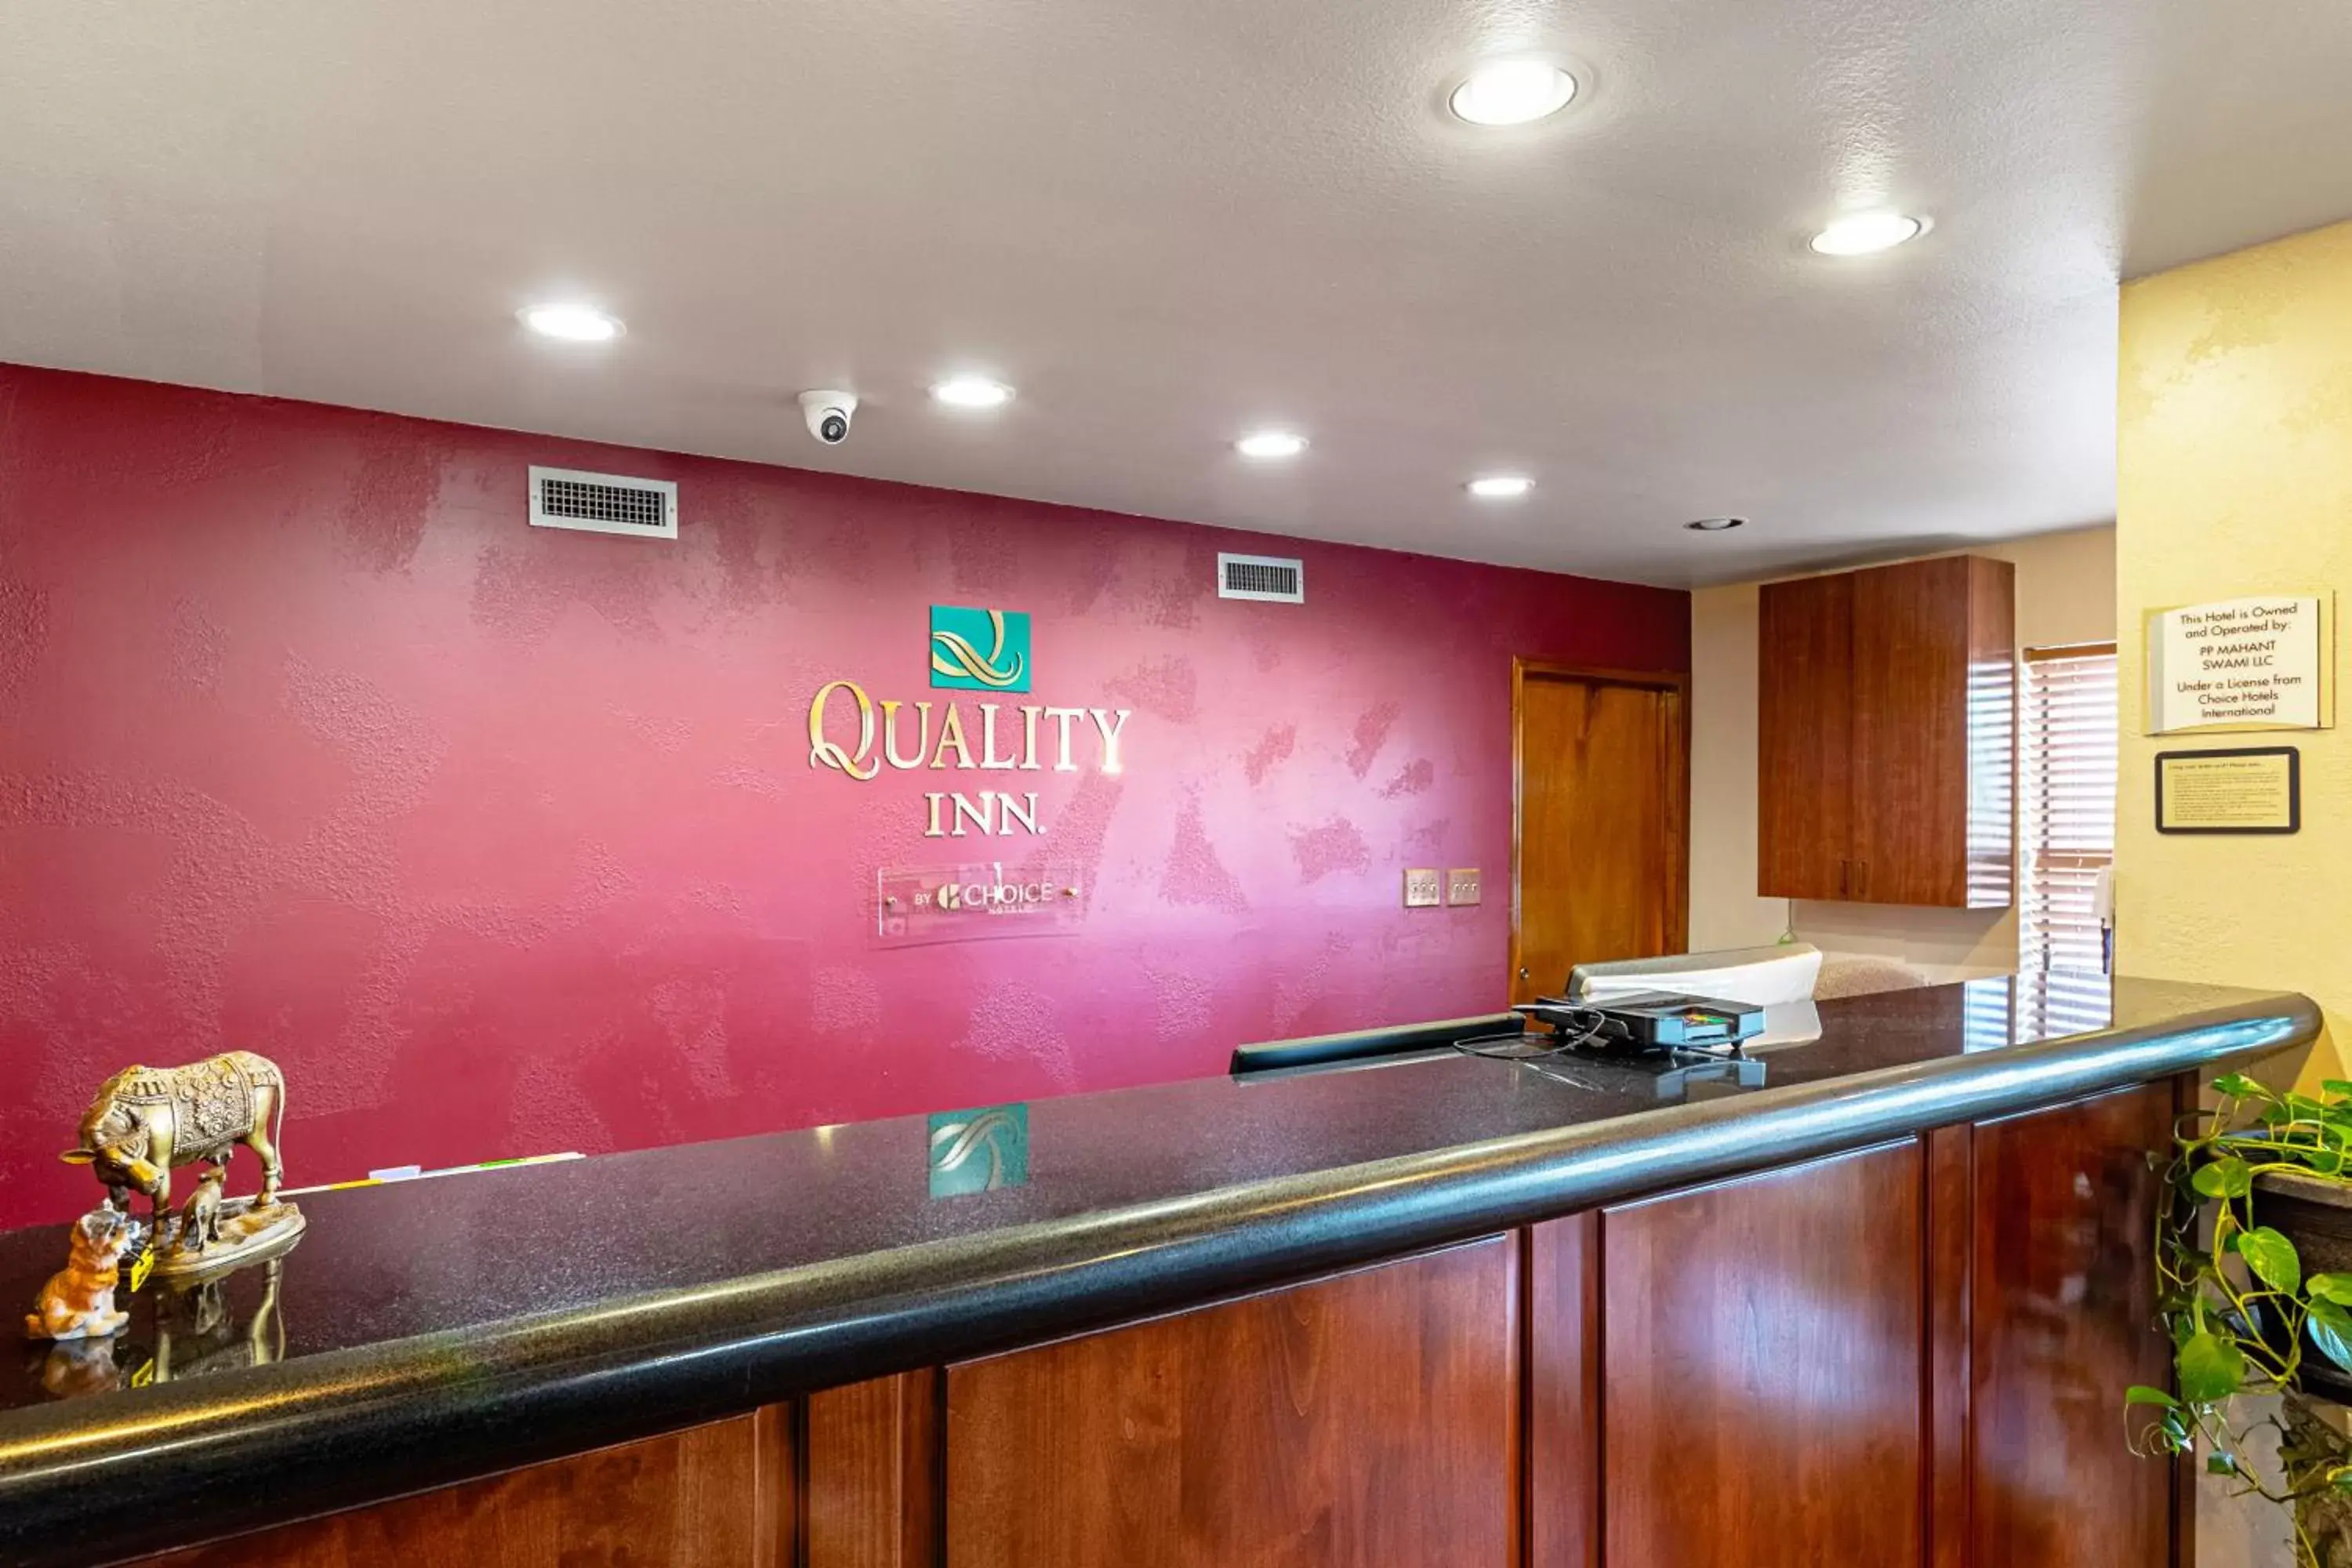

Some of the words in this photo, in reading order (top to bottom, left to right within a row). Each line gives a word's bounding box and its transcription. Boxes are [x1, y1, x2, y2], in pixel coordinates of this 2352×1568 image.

[2180, 615, 2201, 625] This
[2205, 609, 2235, 622] Hotel
[2240, 609, 2249, 619] is
[2252, 602, 2298, 618] Owned
[2185, 626, 2207, 639] and
[2211, 620, 2268, 637] Operated
[2271, 619, 2291, 632] by:
[2200, 645, 2214, 656] PP
[2217, 640, 2276, 655] MAHANT
[2202, 657, 2249, 670] SWAMI
[2252, 655, 2274, 667] LLC
[2177, 680, 2211, 692] Under
[2227, 677, 2270, 689] License
[2273, 673, 2301, 685] from
[2198, 693, 2238, 705] Choice
[2242, 690, 2279, 702] Hotels
[2201, 703, 2276, 718] International
[808, 681, 1131, 781] QUALITY
[915, 892, 931, 905] BY
[964, 883, 1053, 905] CHOICE
